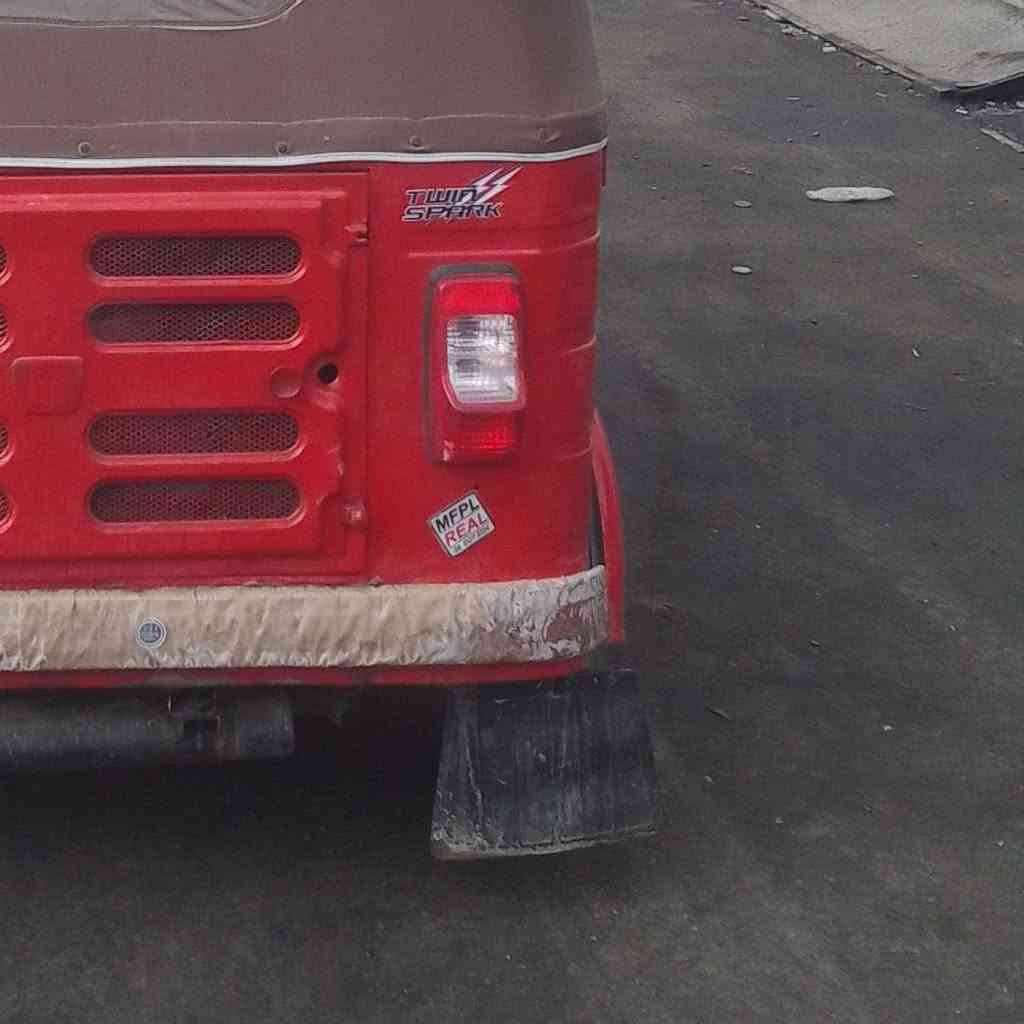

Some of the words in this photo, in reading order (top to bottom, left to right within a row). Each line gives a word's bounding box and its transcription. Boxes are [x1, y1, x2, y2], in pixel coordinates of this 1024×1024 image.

[402, 203, 504, 222] SPARK
[435, 498, 480, 535] MFPL
[444, 513, 488, 547] REAL
